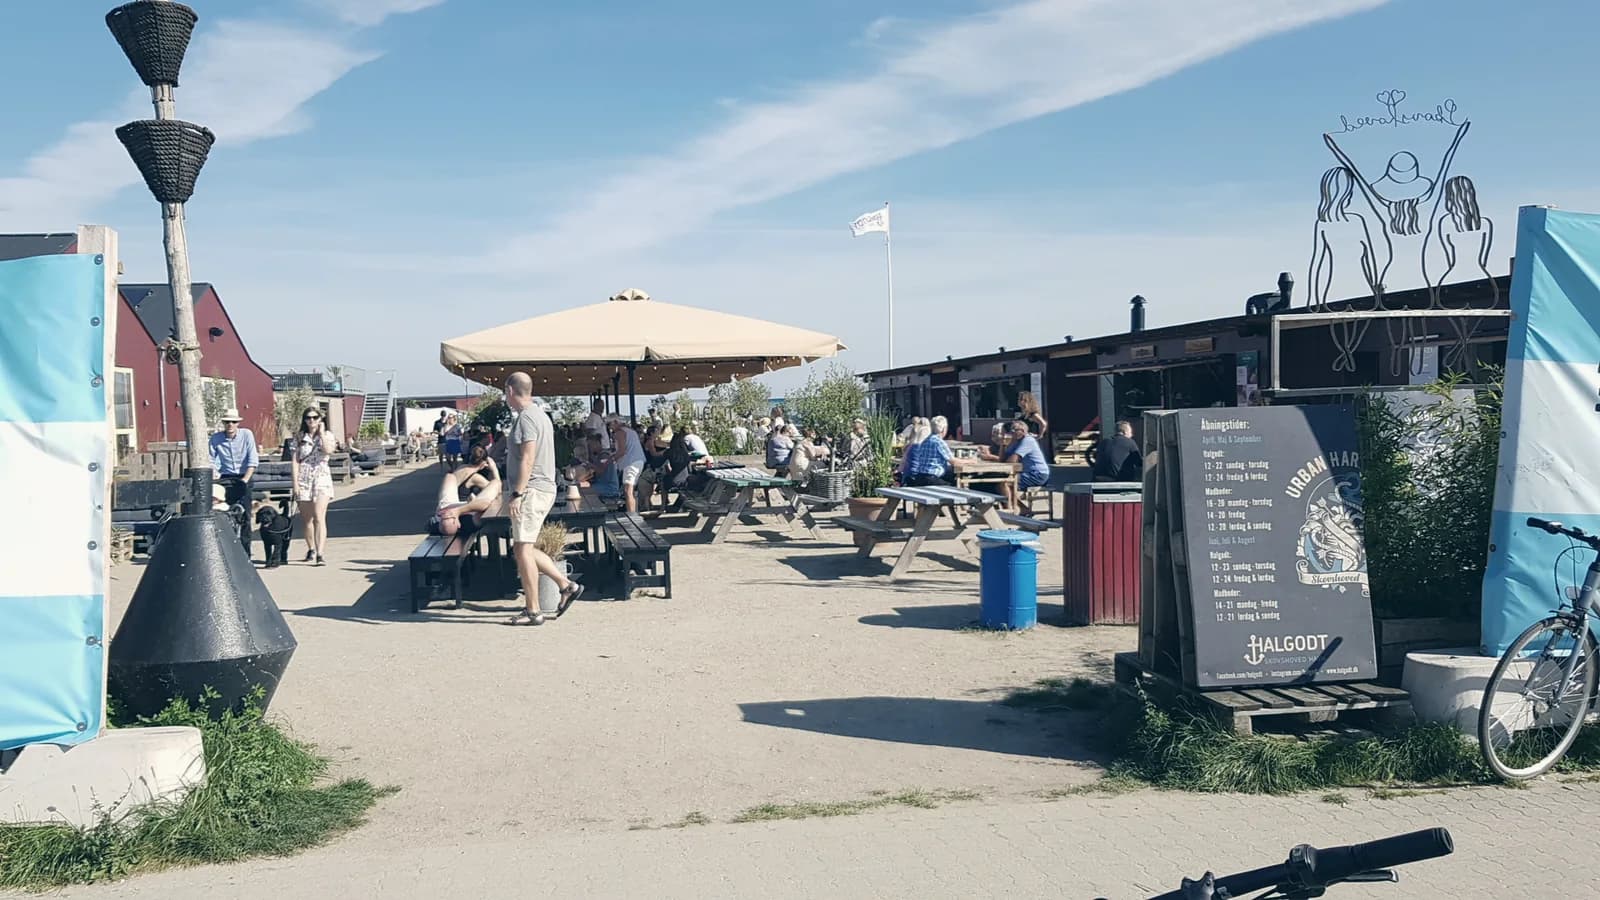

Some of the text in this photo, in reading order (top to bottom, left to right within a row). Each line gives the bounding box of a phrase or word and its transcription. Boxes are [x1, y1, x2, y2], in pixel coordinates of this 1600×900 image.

[1201, 417, 1250, 432] Åbningstider:
[1285, 456, 1328, 498] URBAN
[1245, 634, 1328, 661] HALGODT
